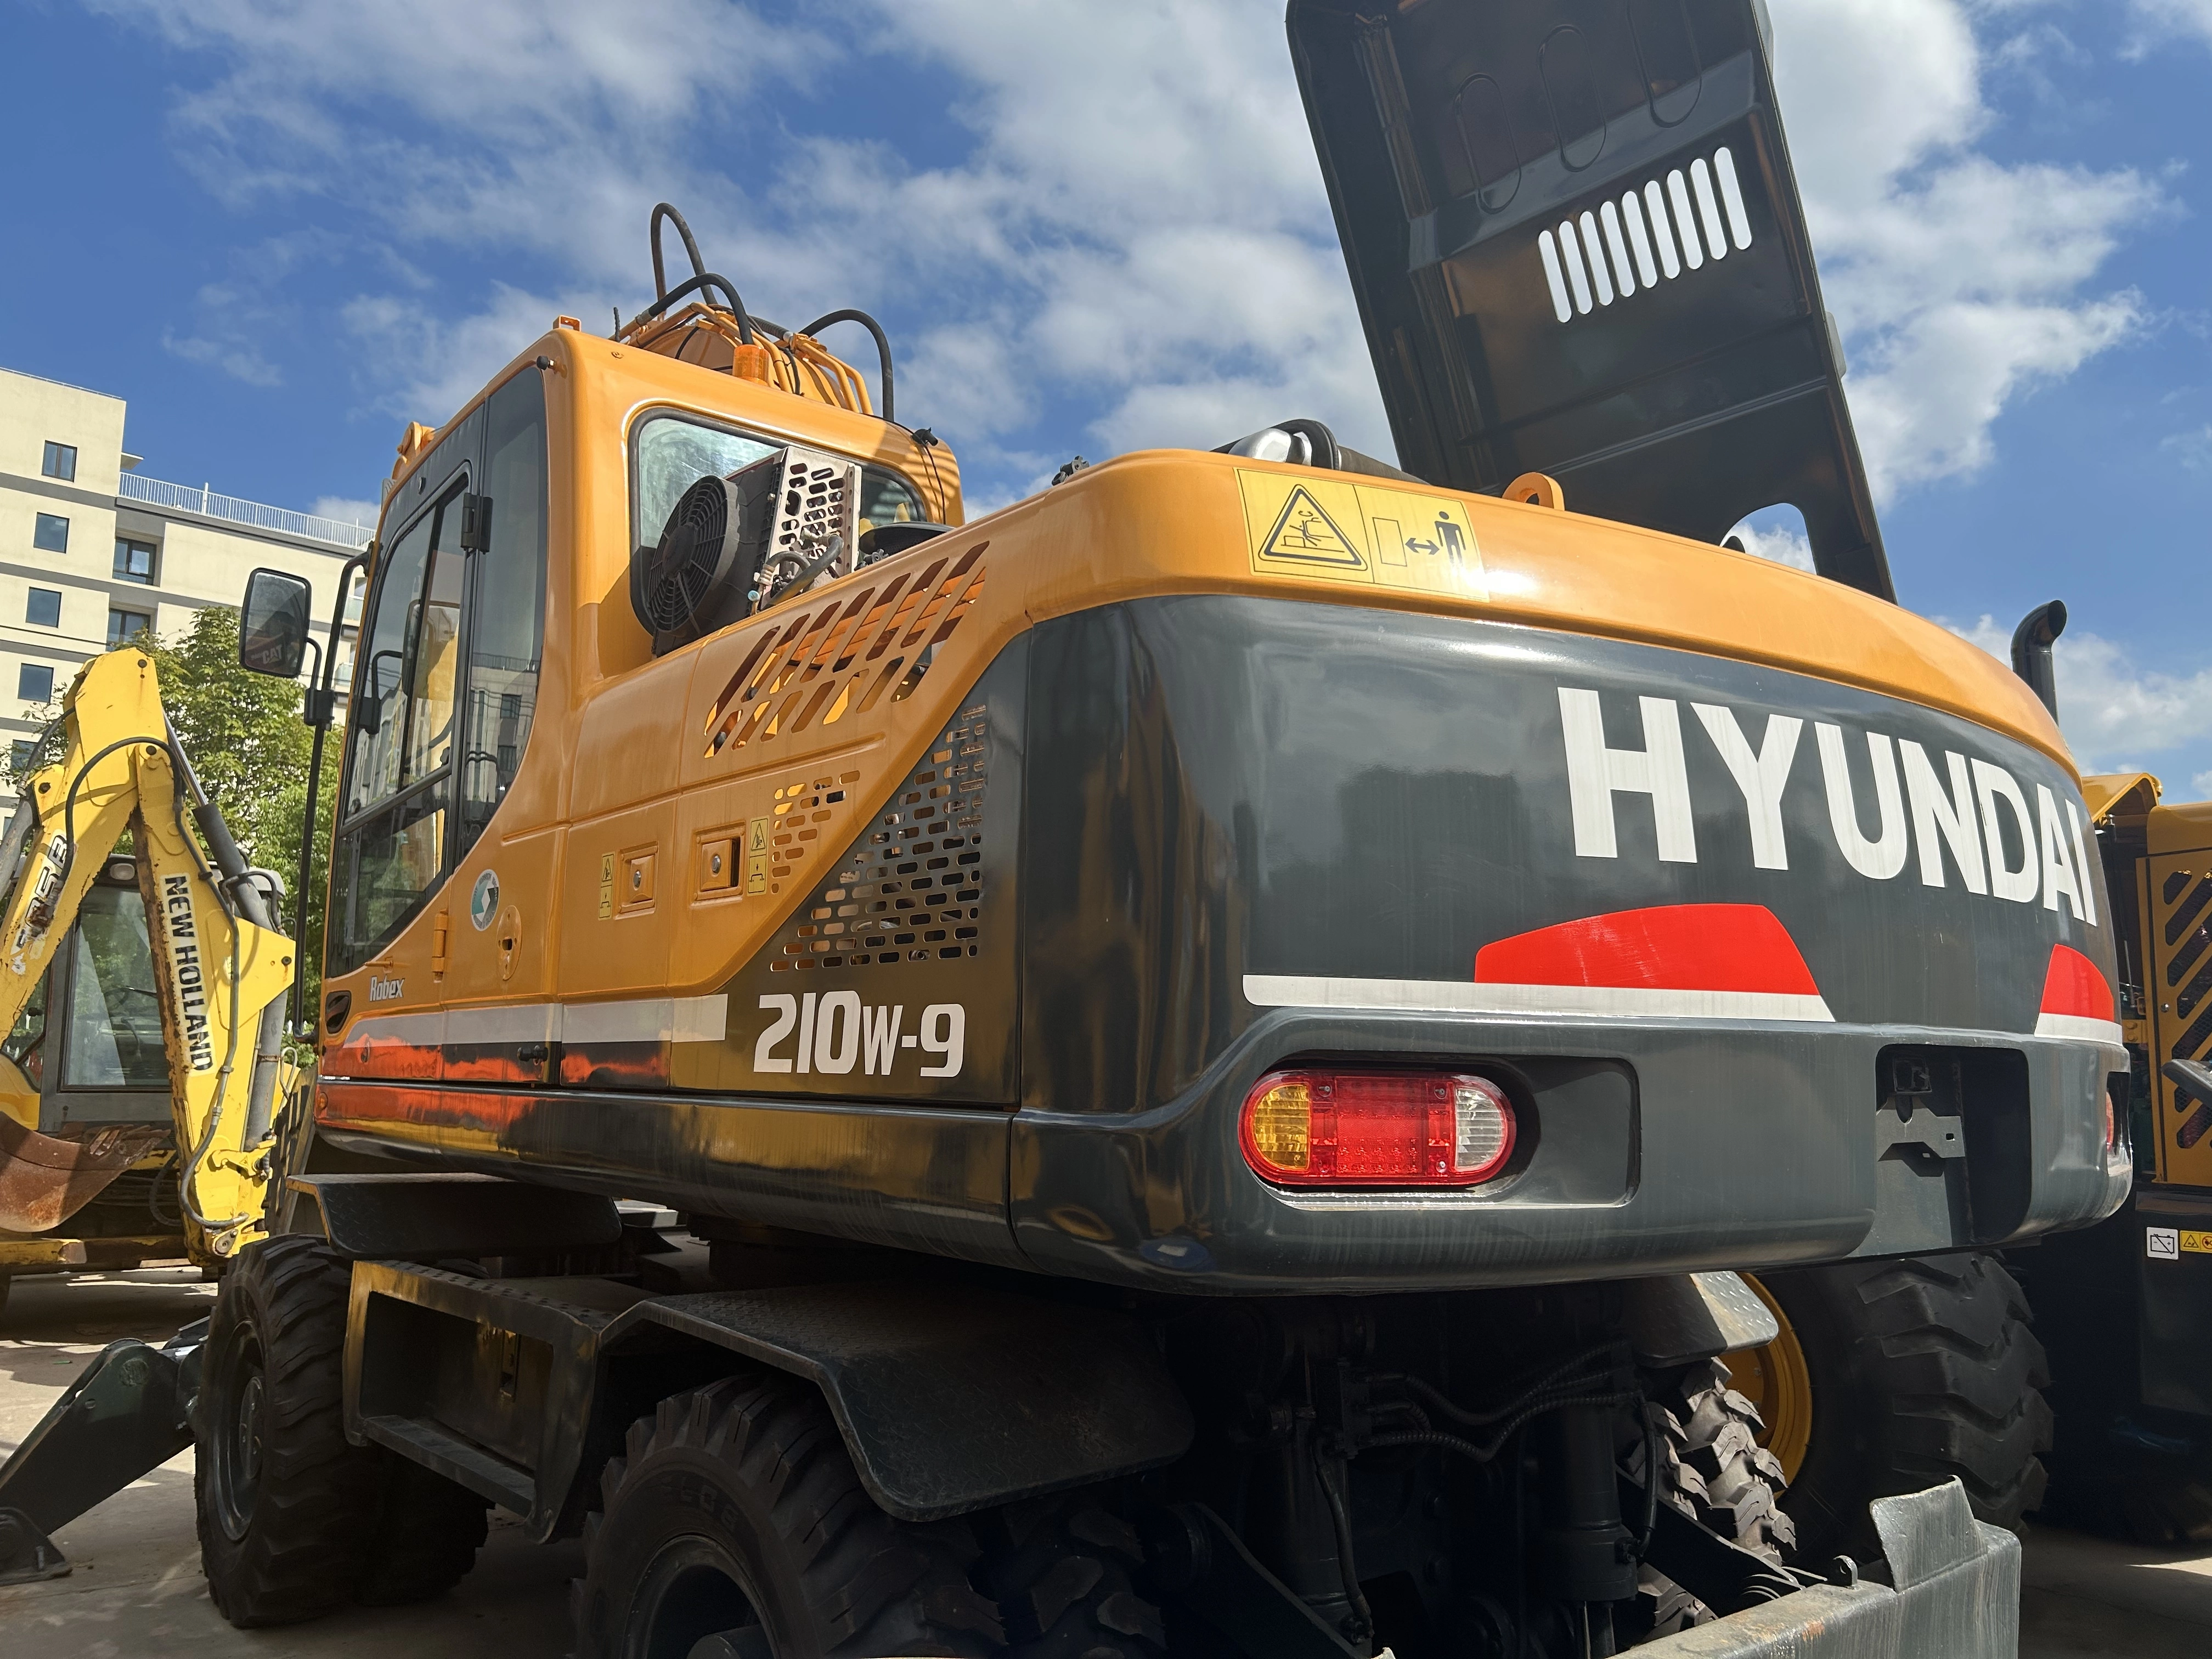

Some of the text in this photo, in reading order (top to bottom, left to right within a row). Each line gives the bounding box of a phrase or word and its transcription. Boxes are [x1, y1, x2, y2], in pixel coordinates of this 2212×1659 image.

[263, 644, 282, 664] CAT
[1557, 686, 2097, 927] HYUNDAI
[165, 876, 213, 1071] NEW HOLLAND
[369, 975, 405, 1002] Robex
